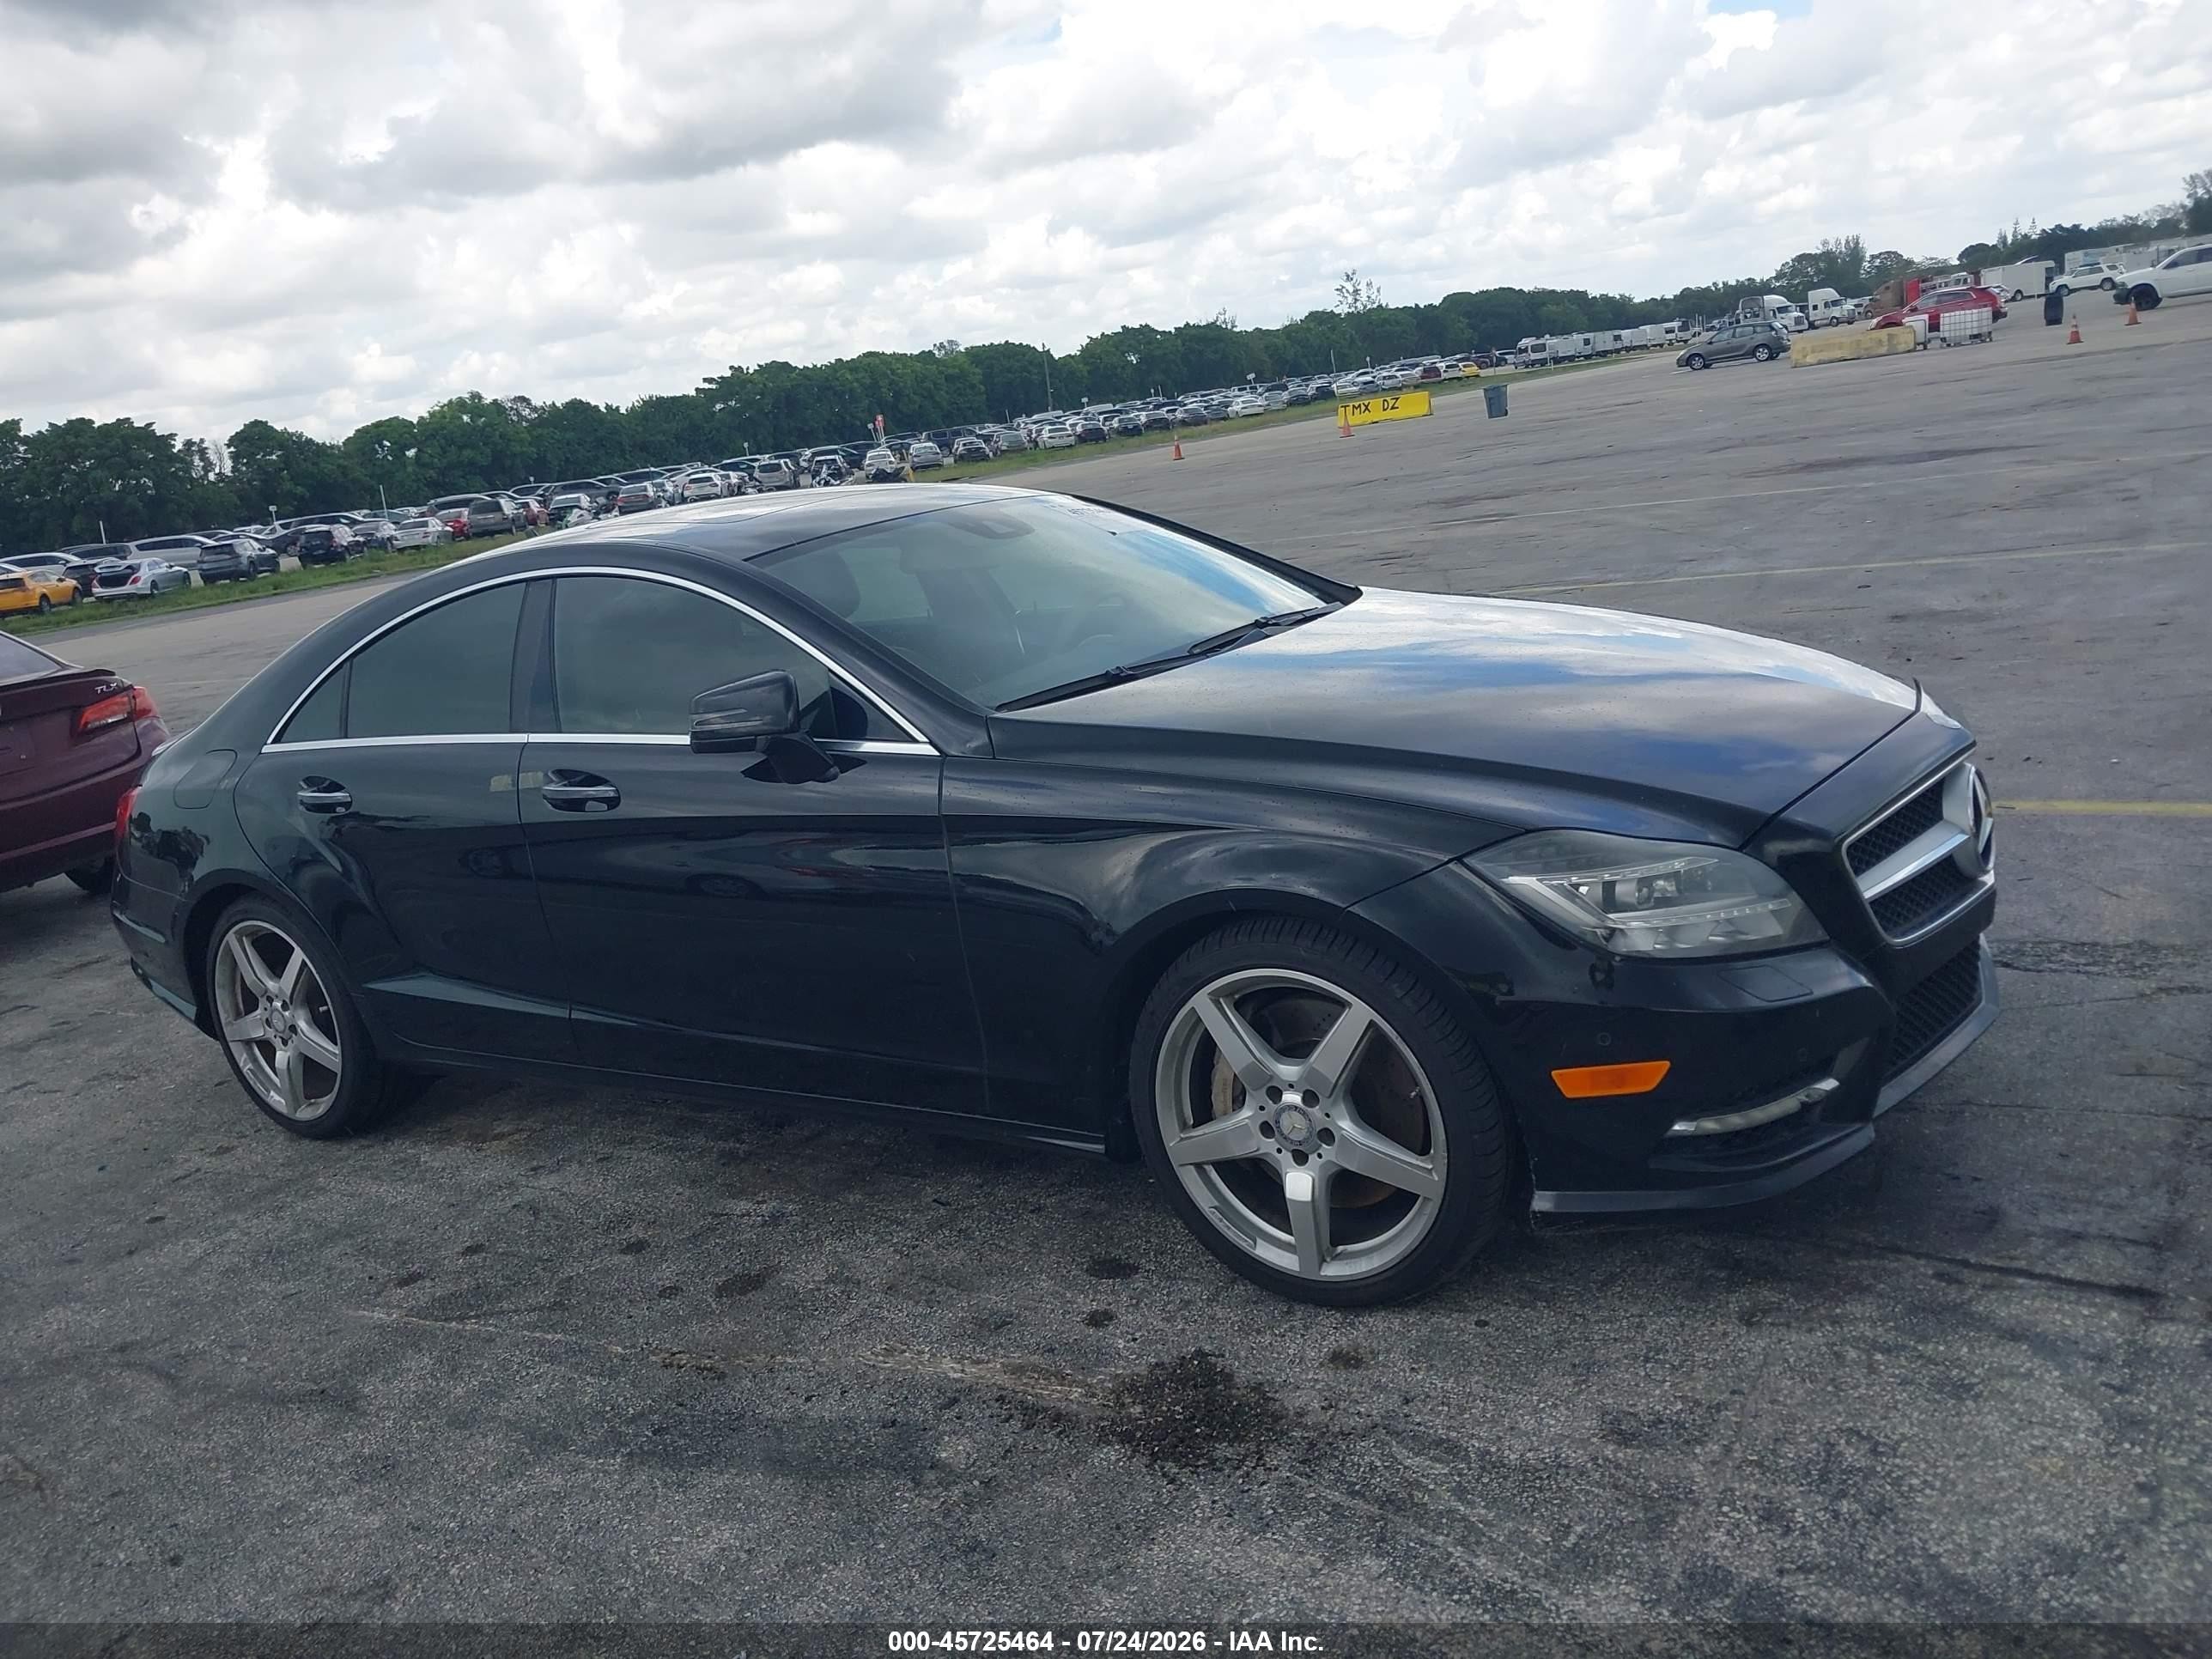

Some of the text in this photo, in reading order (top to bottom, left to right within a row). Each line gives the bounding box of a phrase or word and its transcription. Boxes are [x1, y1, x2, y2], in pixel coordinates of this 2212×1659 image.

[1340, 397, 1401, 416] TMX DZ
[94, 683, 117, 694] TLX
